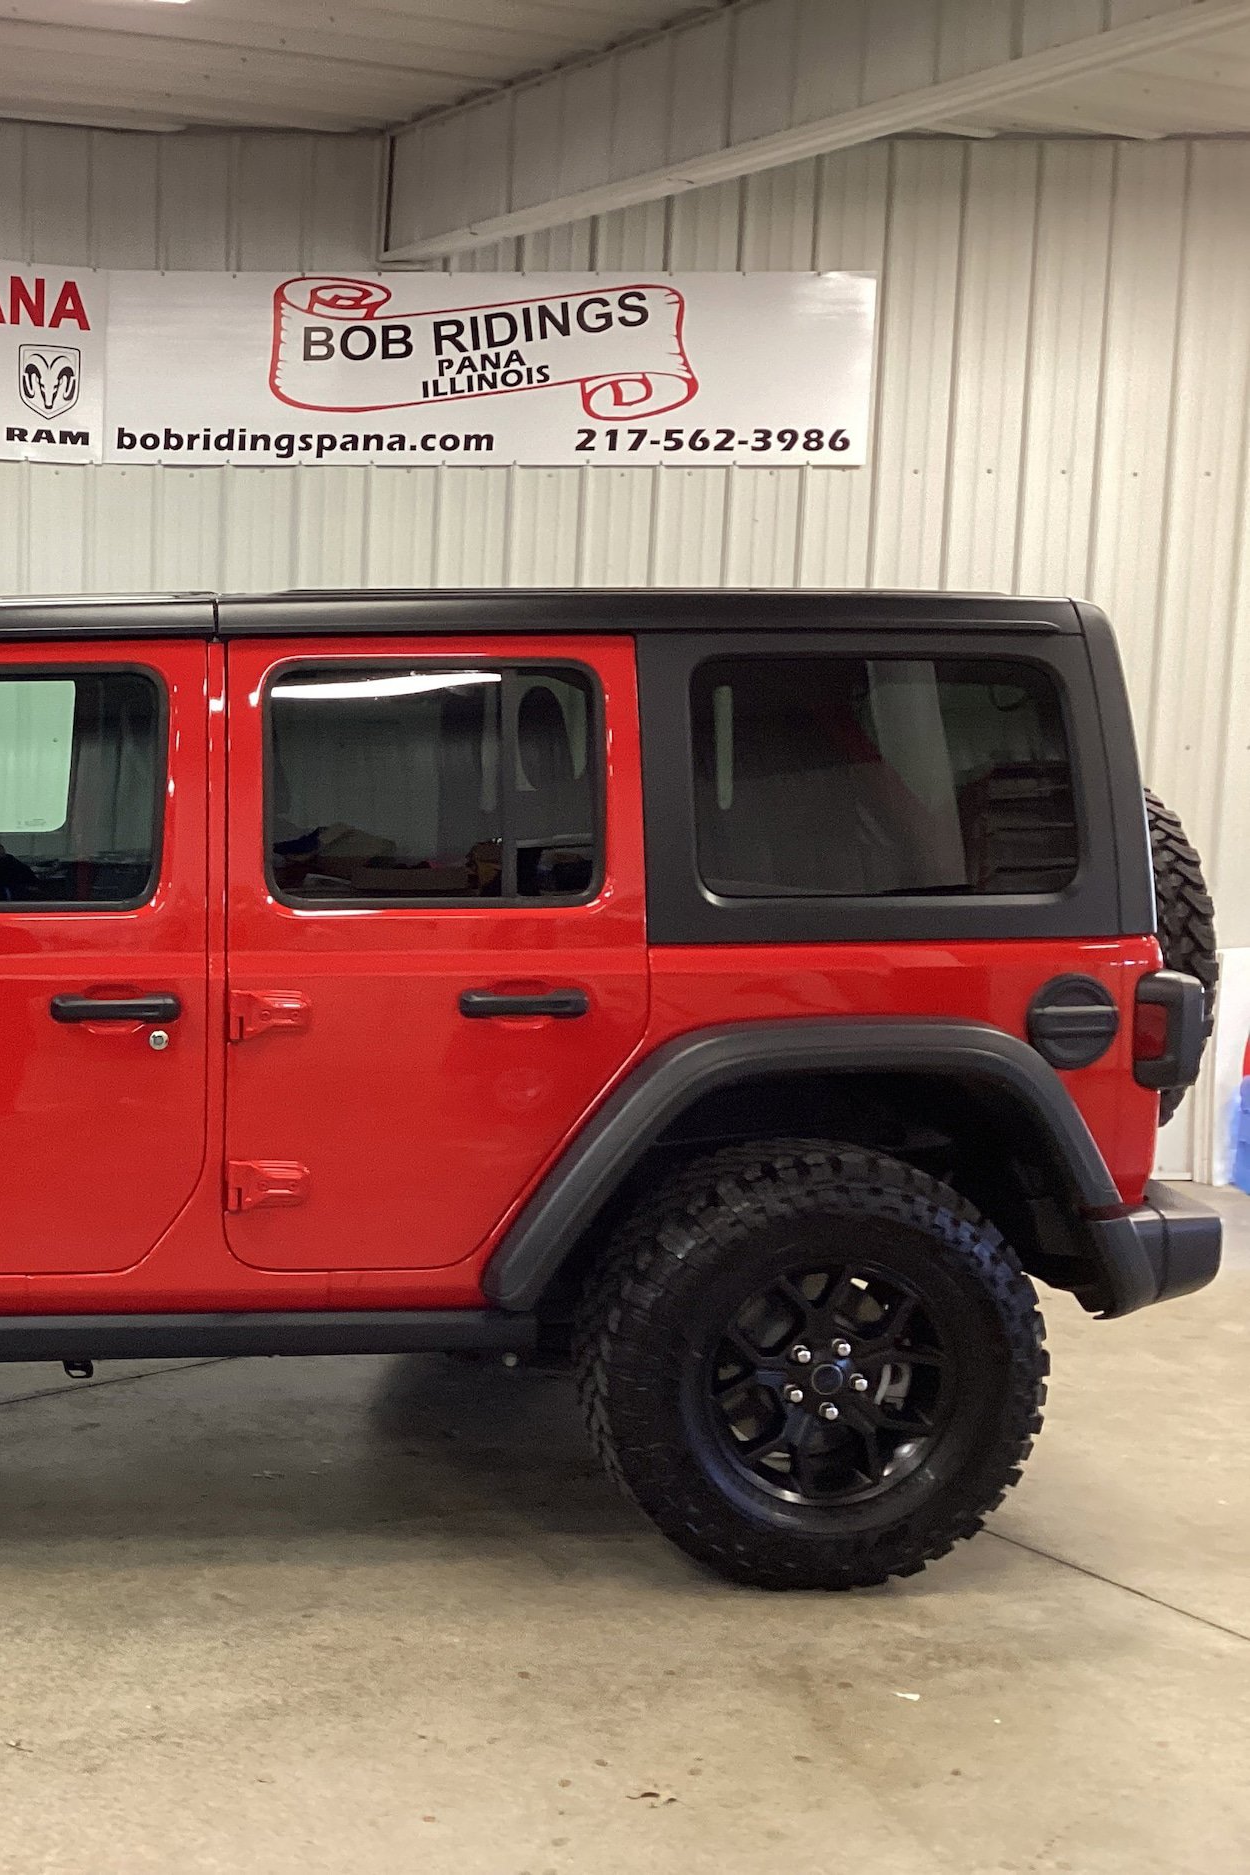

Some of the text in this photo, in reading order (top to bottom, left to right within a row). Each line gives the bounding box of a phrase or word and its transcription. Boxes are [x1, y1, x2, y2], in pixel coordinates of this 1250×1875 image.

[303, 291, 650, 361] BOB RIDINGS
[438, 349, 527, 377] PANA
[422, 364, 550, 398] ILLINOIS
[6, 426, 90, 446] RAM
[116, 427, 494, 459] bobridingspana.com
[575, 428, 851, 452] 217-562-3986
